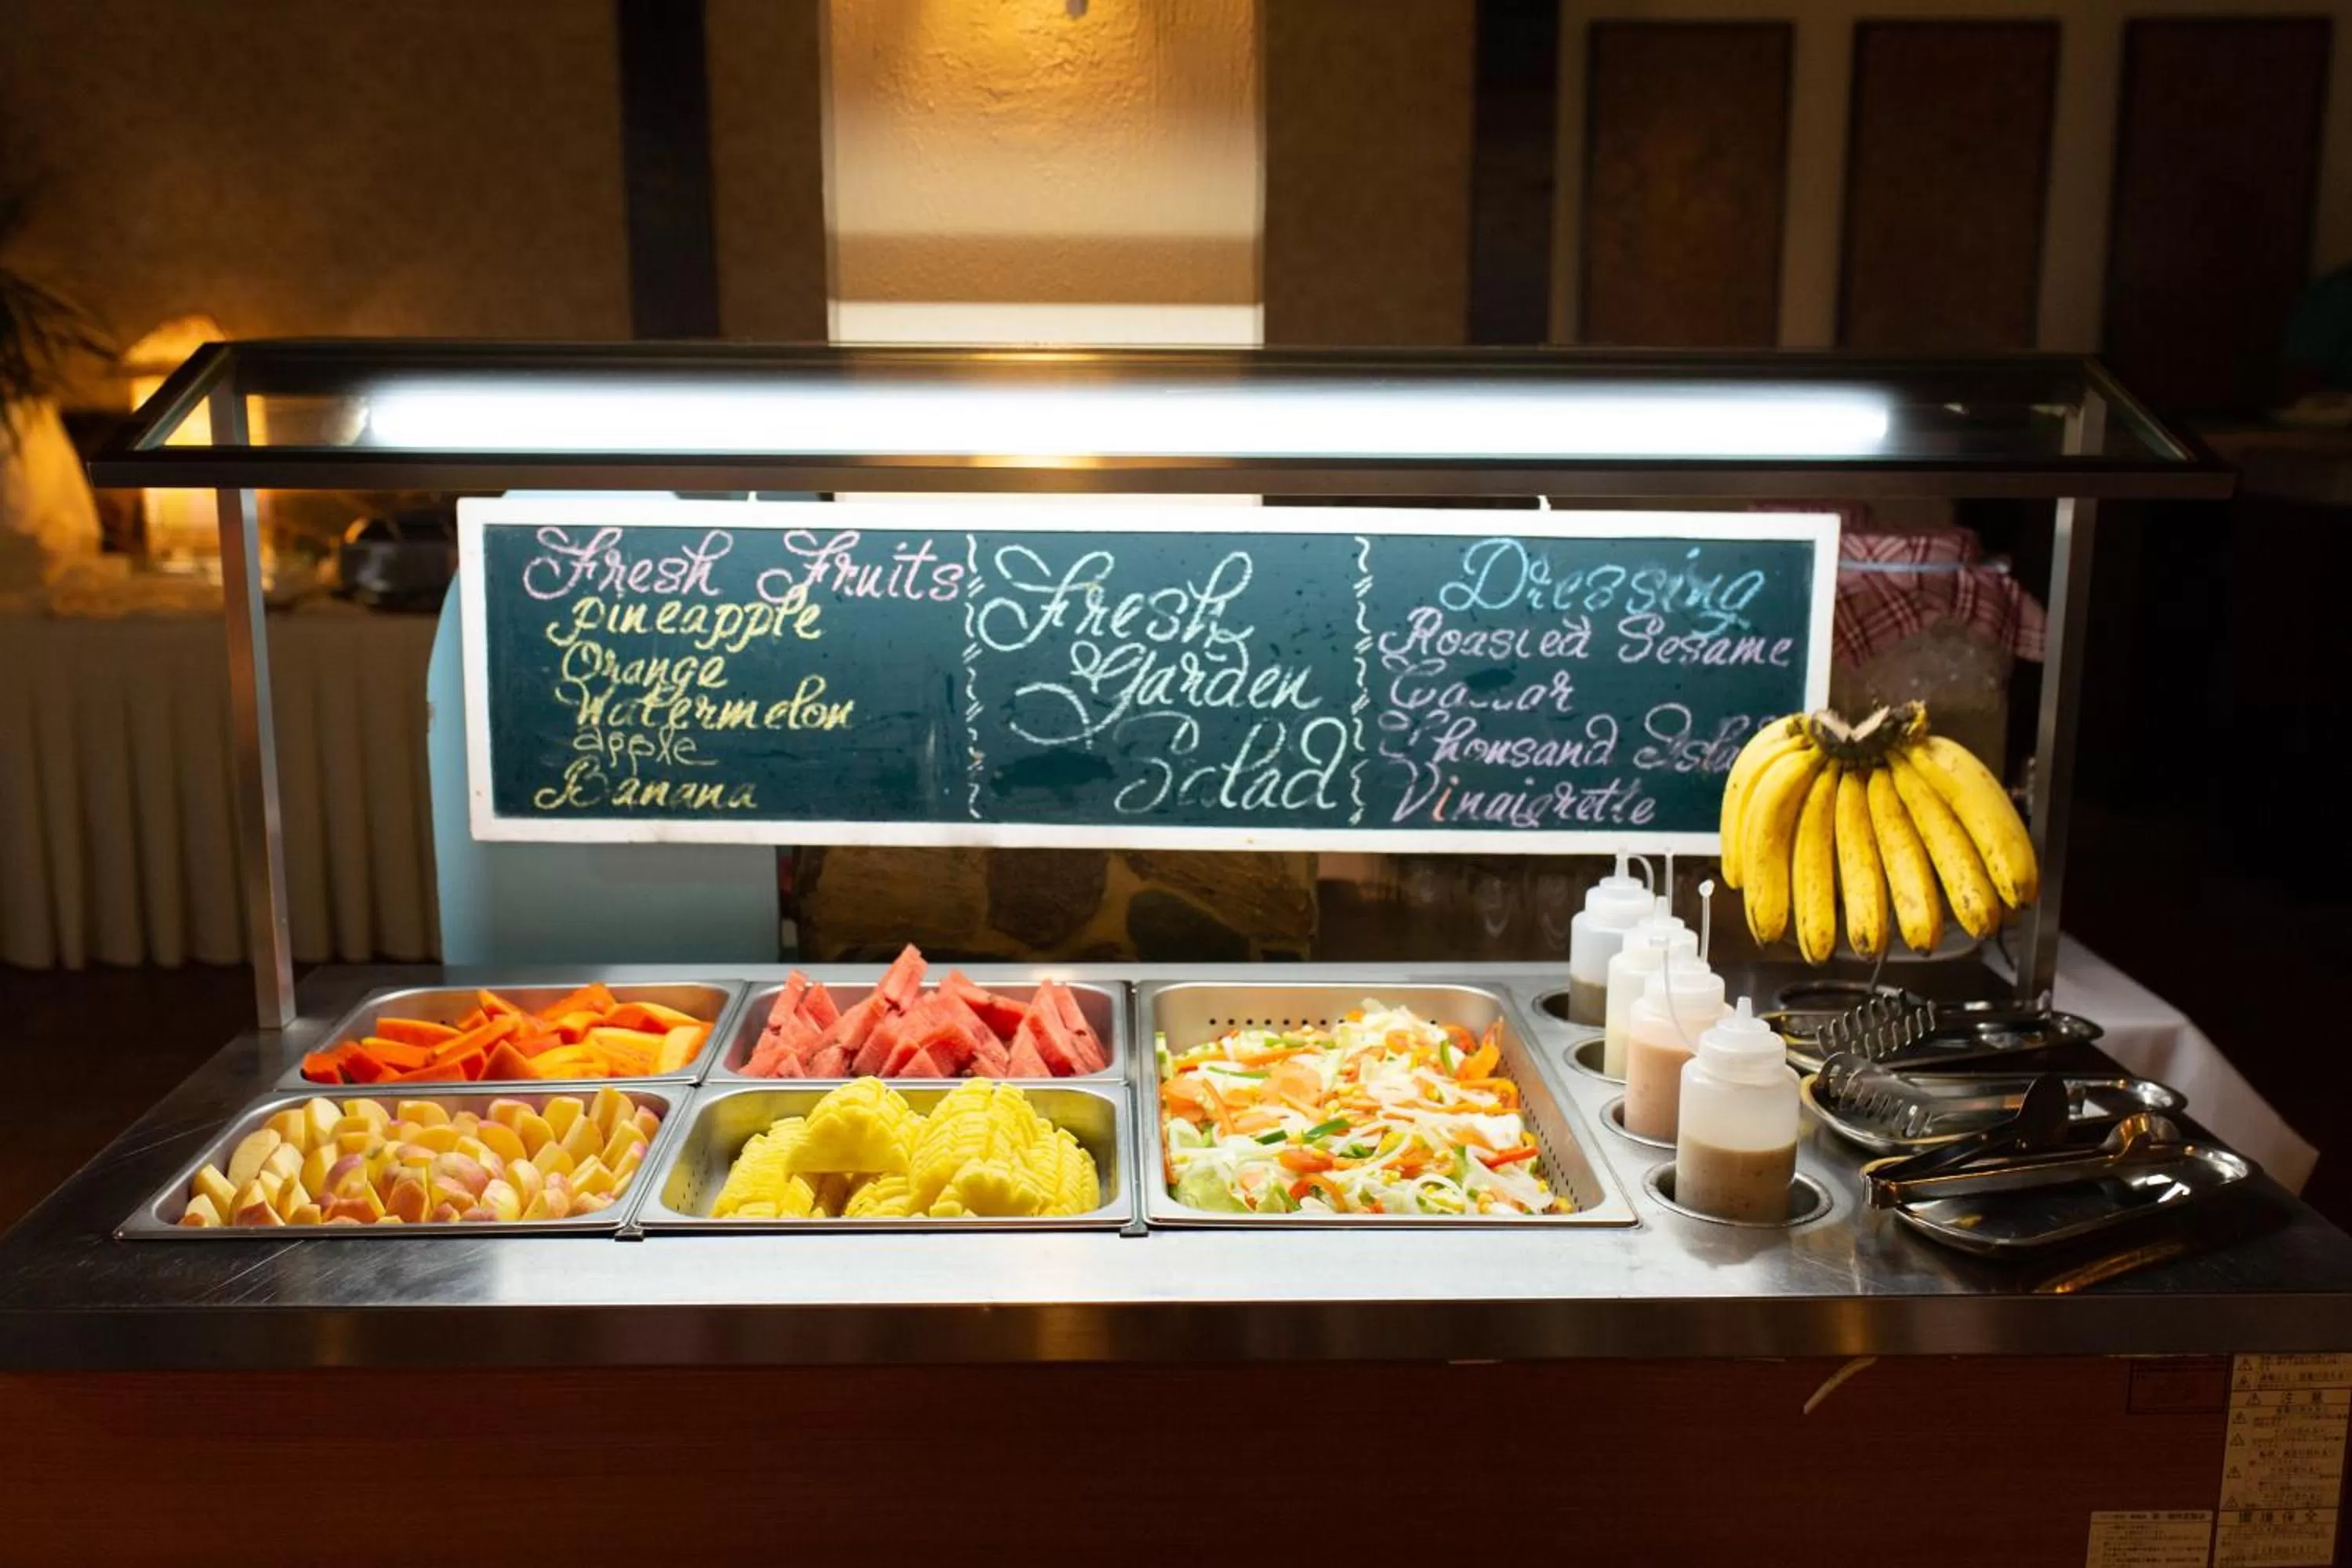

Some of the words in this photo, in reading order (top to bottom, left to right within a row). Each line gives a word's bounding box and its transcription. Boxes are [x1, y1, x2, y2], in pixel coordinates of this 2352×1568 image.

[523, 526, 734, 600] Fresh
[757, 529, 967, 604] Fruits
[978, 545, 1254, 652] Fresh
[1439, 537, 1765, 638] Dressing
[561, 641, 728, 704] Orange
[1618, 612, 1795, 666] Sesame
[554, 674, 856, 731] Watermelon
[1010, 641, 1323, 750] Garden
[1381, 657, 1575, 713] Caar
[1377, 709, 1619, 768] Thousand
[1633, 702, 1777, 773] Isla
[534, 755, 758, 810] Banana
